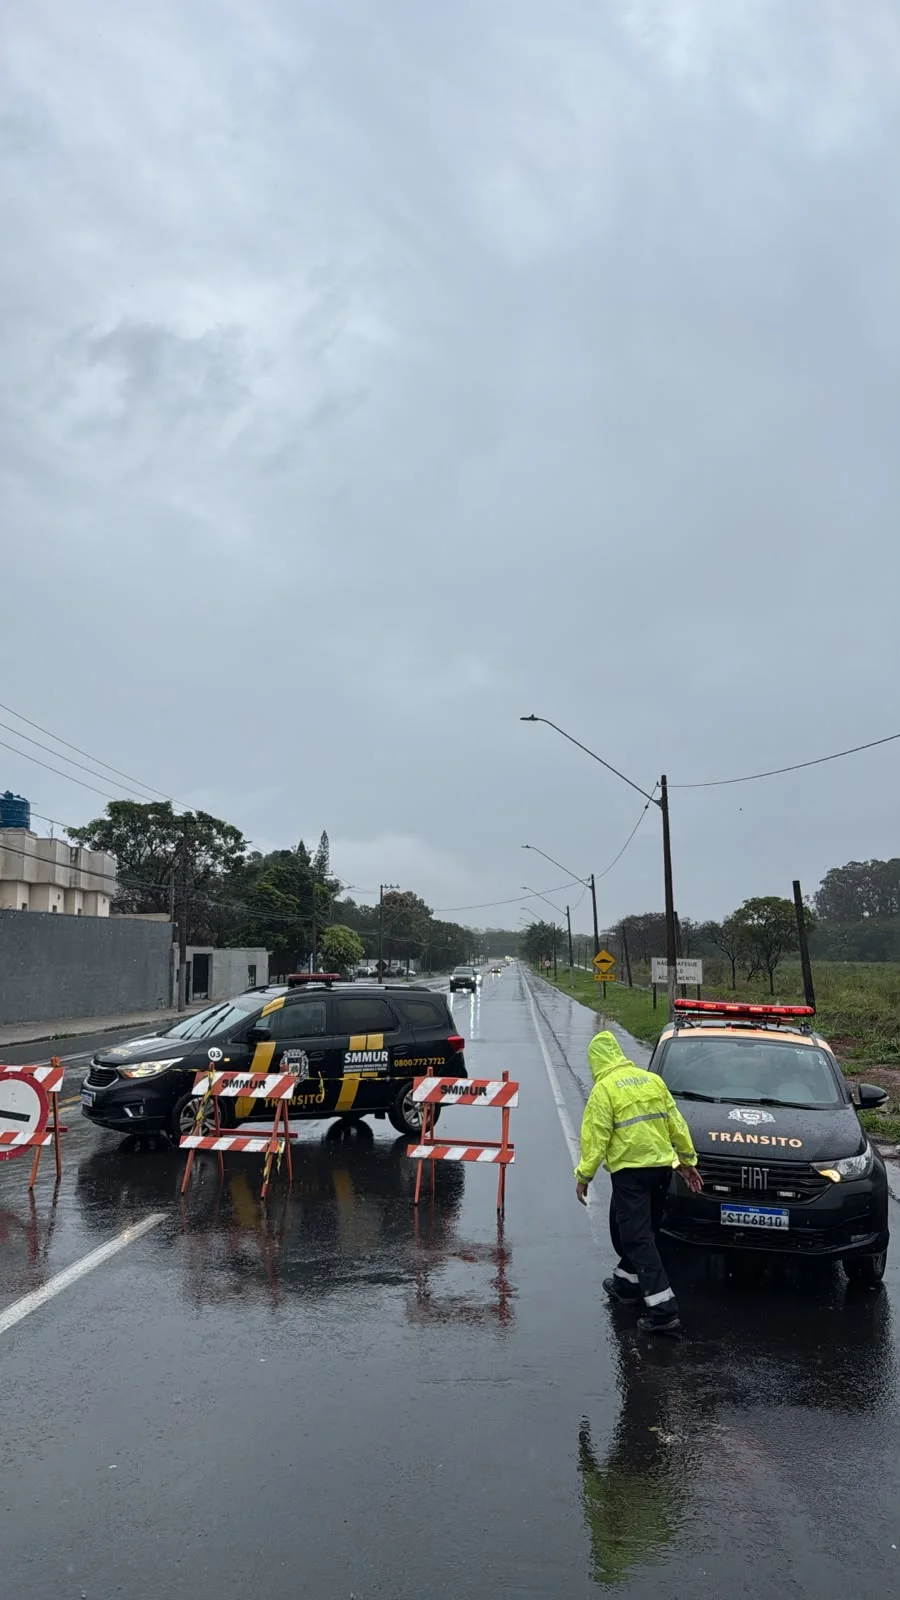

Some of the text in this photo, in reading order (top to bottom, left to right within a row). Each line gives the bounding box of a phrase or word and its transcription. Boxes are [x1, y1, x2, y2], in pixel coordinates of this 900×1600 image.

[209, 1050, 222, 1059] 03
[344, 1051, 389, 1064] SMMUR
[221, 1078, 266, 1090] SMMUR
[440, 1084, 488, 1097] SMMUR
[264, 1093, 325, 1108] TRNSITO
[708, 1131, 803, 1148] TRÂNSITO
[741, 1166, 770, 1190] FIAT
